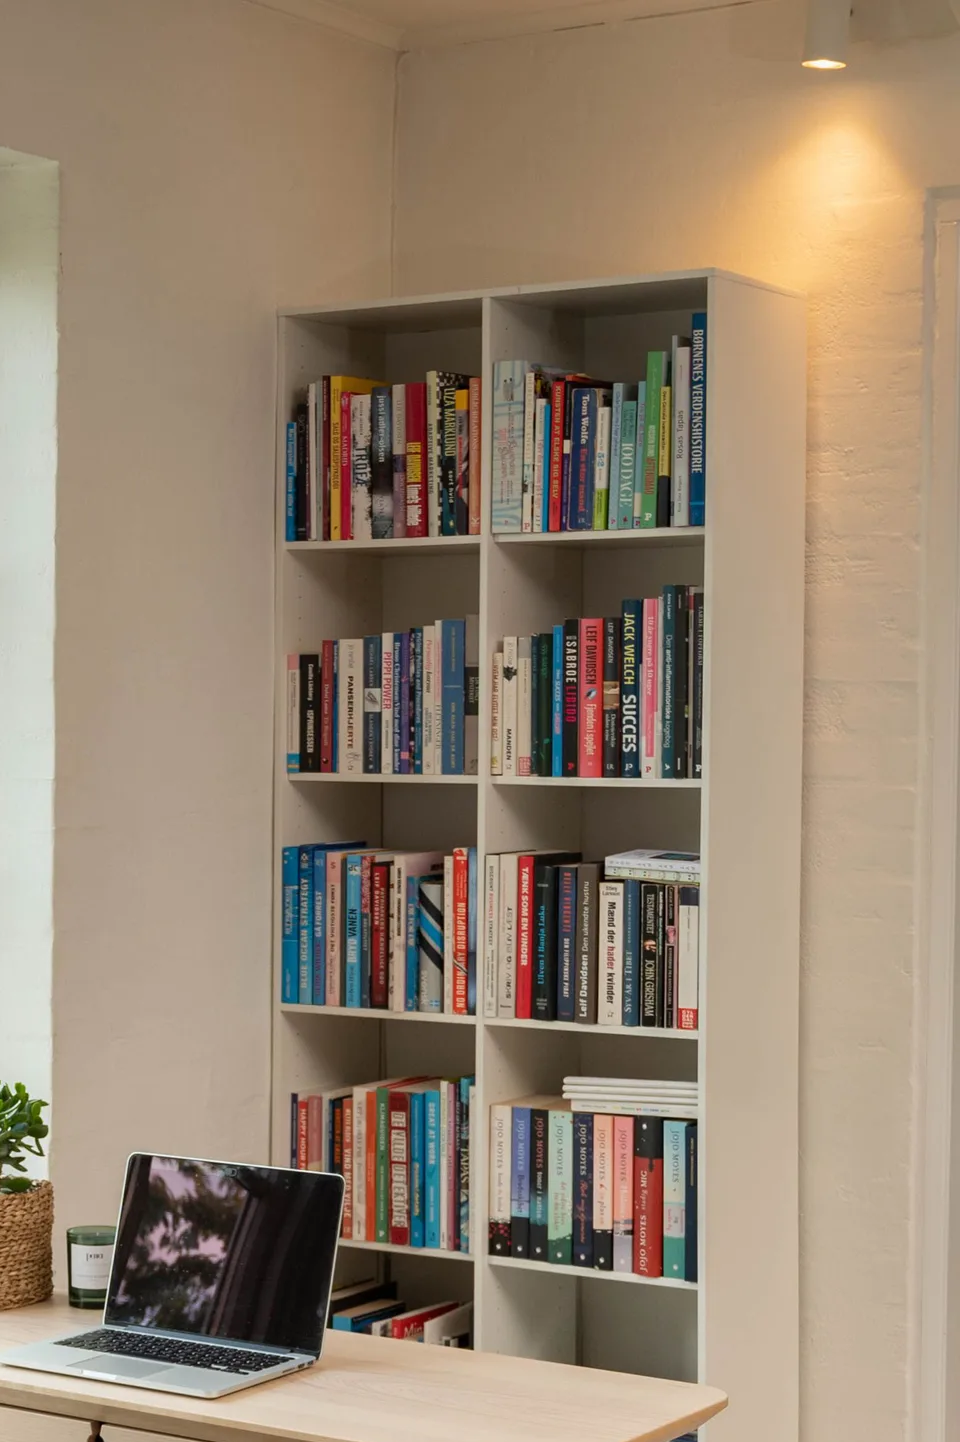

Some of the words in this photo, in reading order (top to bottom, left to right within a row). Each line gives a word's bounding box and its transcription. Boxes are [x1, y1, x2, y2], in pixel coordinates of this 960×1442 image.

[692, 329, 705, 382] BØRNENES
[443, 388, 456, 406] LIZA
[581, 394, 590, 416] Tom
[443, 408, 456, 457] MARKLUND
[554, 425, 560, 436] AT
[580, 416, 590, 445] Wolfe
[676, 410, 685, 433] Tapas
[691, 384, 704, 474] VERDENSHISTORIE
[621, 442, 634, 466] 100
[619, 468, 633, 508] DAGE
[585, 625, 598, 643] LEIF
[623, 612, 635, 642] JACK
[665, 634, 673, 648] Den
[383, 651, 392, 675] PIPPI
[565, 641, 577, 683] SABROE
[585, 645, 598, 685] DAVIDSEN
[623, 644, 635, 685] WELCH
[383, 677, 392, 710] POWER
[665, 649, 673, 720] anti-inflammatoriske
[346, 675, 354, 749] PANSERHJERTE
[565, 685, 577, 723] LIBIDO
[584, 703, 596, 729] Fjenden
[622, 694, 637, 753] SUCCES
[663, 720, 673, 749] kogebog
[583, 734, 596, 756] spejlet
[520, 866, 529, 894] TÆNK
[582, 881, 590, 905] hustru
[300, 878, 309, 927] STRATEGY
[520, 895, 529, 917] SOM
[606, 901, 617, 928] Mænd
[646, 894, 654, 935] TESTAMENTET
[347, 908, 358, 937] VANEN
[456, 902, 466, 950] DISRUPTION
[520, 917, 529, 931] EN
[582, 906, 590, 936] ukendte
[300, 930, 309, 962] OCEAN
[520, 931, 529, 966] VINDER
[582, 937, 590, 952] Den
[606, 929, 617, 944] der
[606, 945, 617, 970] hader
[644, 959, 655, 981] JOHN
[300, 965, 309, 989] BLUE
[579, 954, 588, 997] Davidsen
[606, 972, 617, 1004] kvinder
[456, 997, 466, 1008] NO
[579, 999, 588, 1017] Leif
[644, 981, 655, 1017] GRISHAM
[299, 1108, 307, 1136] HAPPY
[392, 1111, 405, 1127] DE
[427, 1101, 436, 1128] GREAT
[495, 1118, 504, 1138] JOJO
[534, 1116, 544, 1137] JOJO
[427, 1128, 436, 1140] AT
[516, 1119, 525, 1140] JOJO
[555, 1124, 564, 1145] JOJO
[578, 1123, 588, 1144] JOJO
[598, 1129, 606, 1149] JOJO
[618, 1129, 628, 1150] JOJO
[670, 1129, 680, 1151] JOJO
[299, 1137, 307, 1161] HOUR
[344, 1148, 352, 1170] VIND
[392, 1130, 406, 1161] VILDE
[427, 1141, 436, 1165] WORK
[496, 1141, 504, 1169] MOYES
[517, 1142, 525, 1171] MOYES
[536, 1139, 544, 1169] MOYES
[460, 1146, 469, 1183] TAPAS
[556, 1147, 564, 1176] MOYES
[580, 1146, 588, 1175] MOYES
[620, 1152, 628, 1182] MOYES
[672, 1153, 680, 1183] MOYES
[344, 1171, 352, 1192] MED
[640, 1170, 648, 1188] MIG
[344, 1193, 352, 1218] VILJE
[392, 1164, 407, 1228] DETEKTIVER
[639, 1214, 647, 1247] MOYES
[639, 1248, 648, 1272] JOJO
